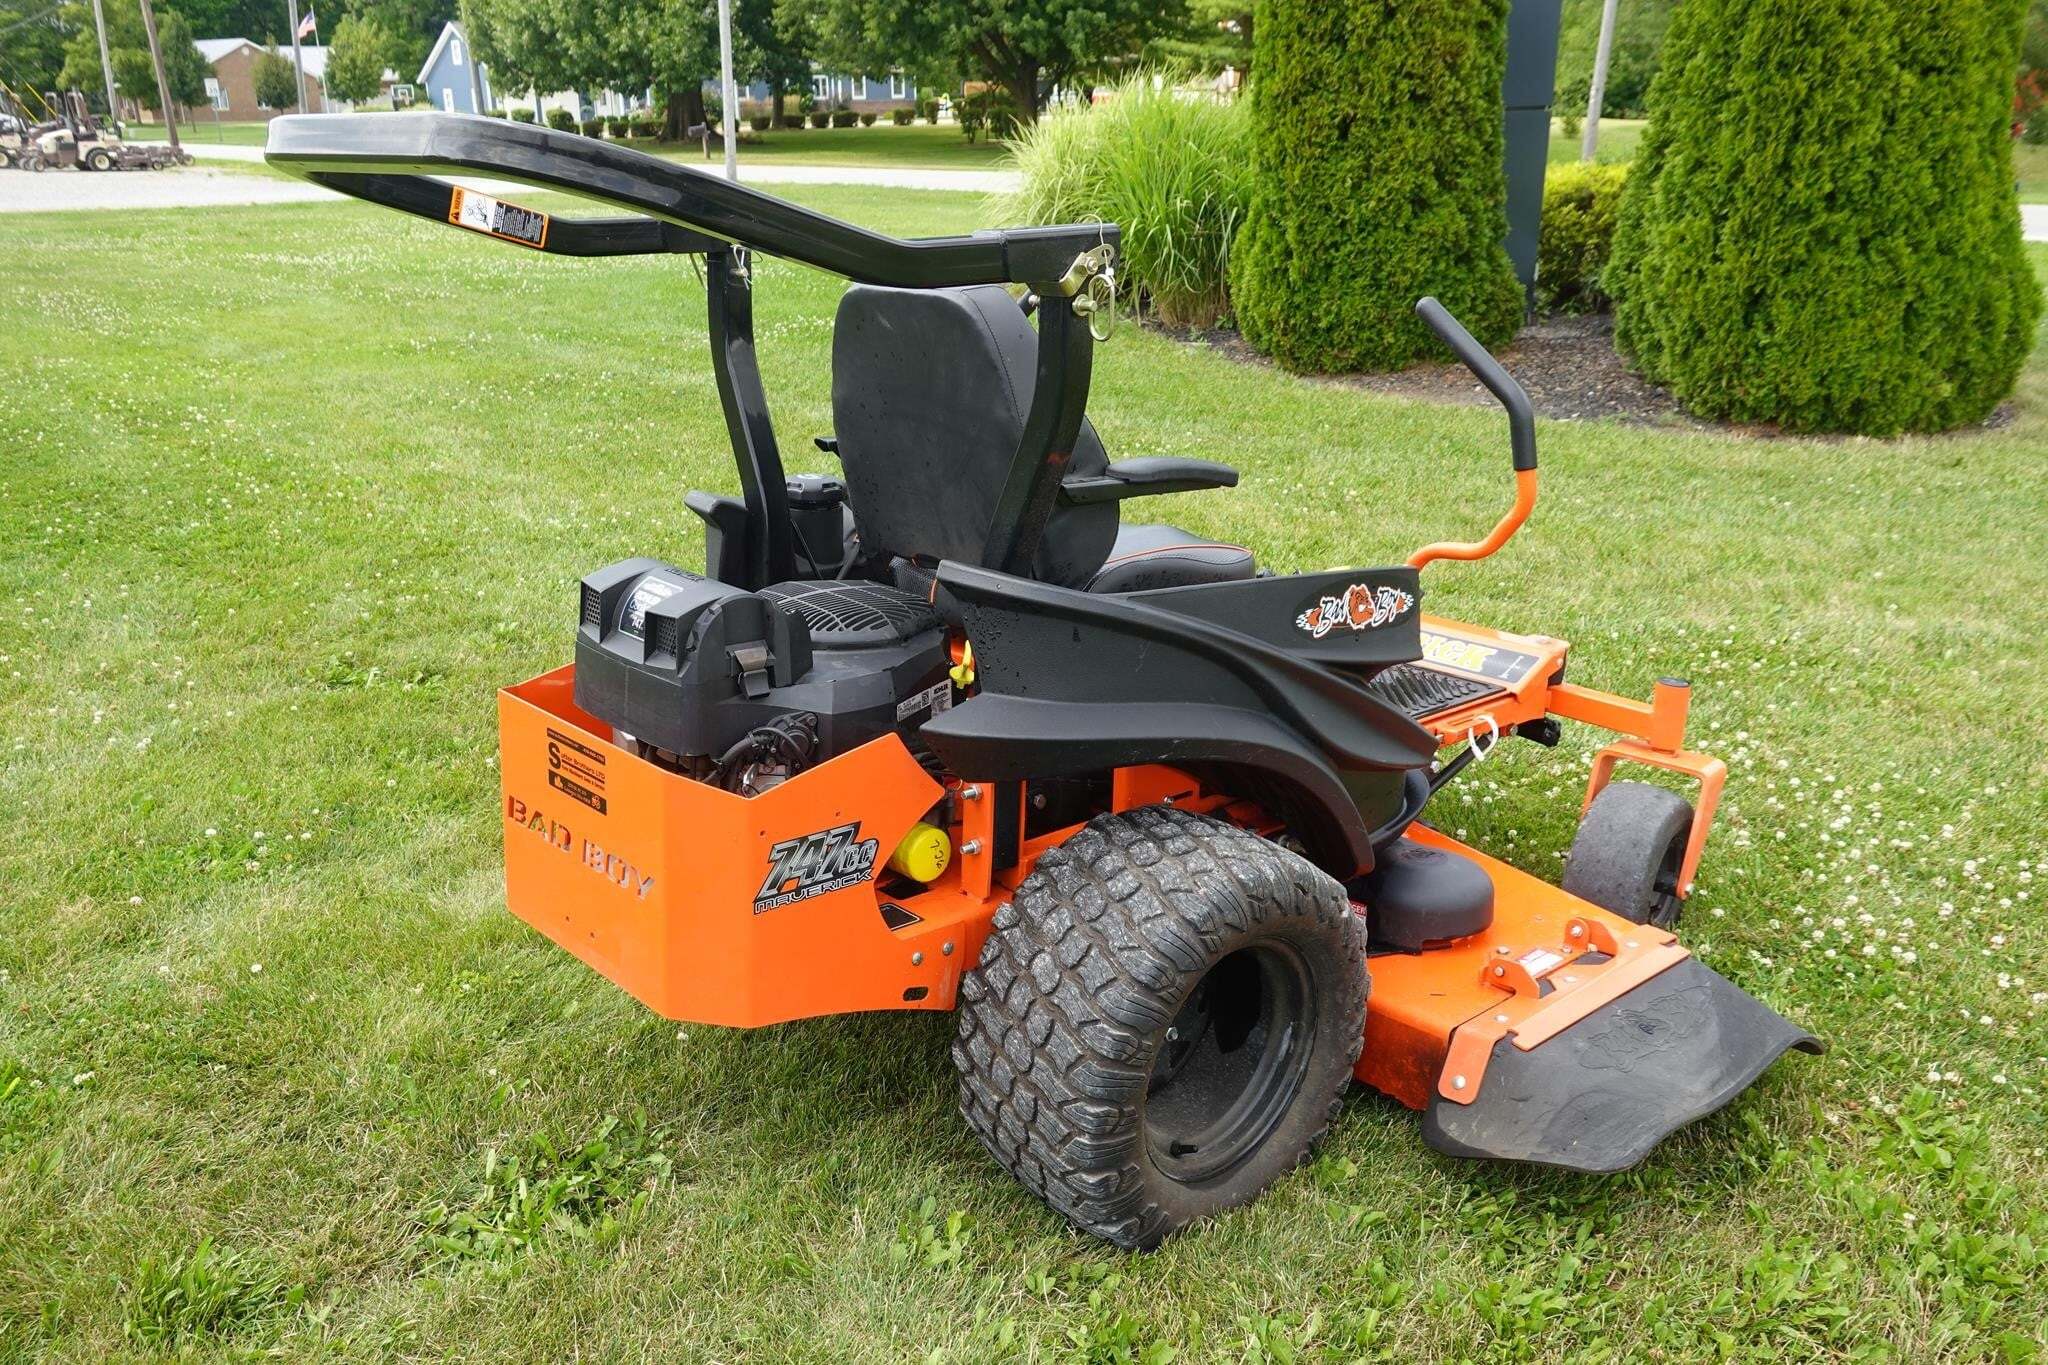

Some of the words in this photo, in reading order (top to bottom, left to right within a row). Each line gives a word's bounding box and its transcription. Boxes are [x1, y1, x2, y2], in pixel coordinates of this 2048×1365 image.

[508, 795, 571, 853] BAD
[582, 838, 655, 901] BOY
[754, 867, 875, 914] MAVERICK
